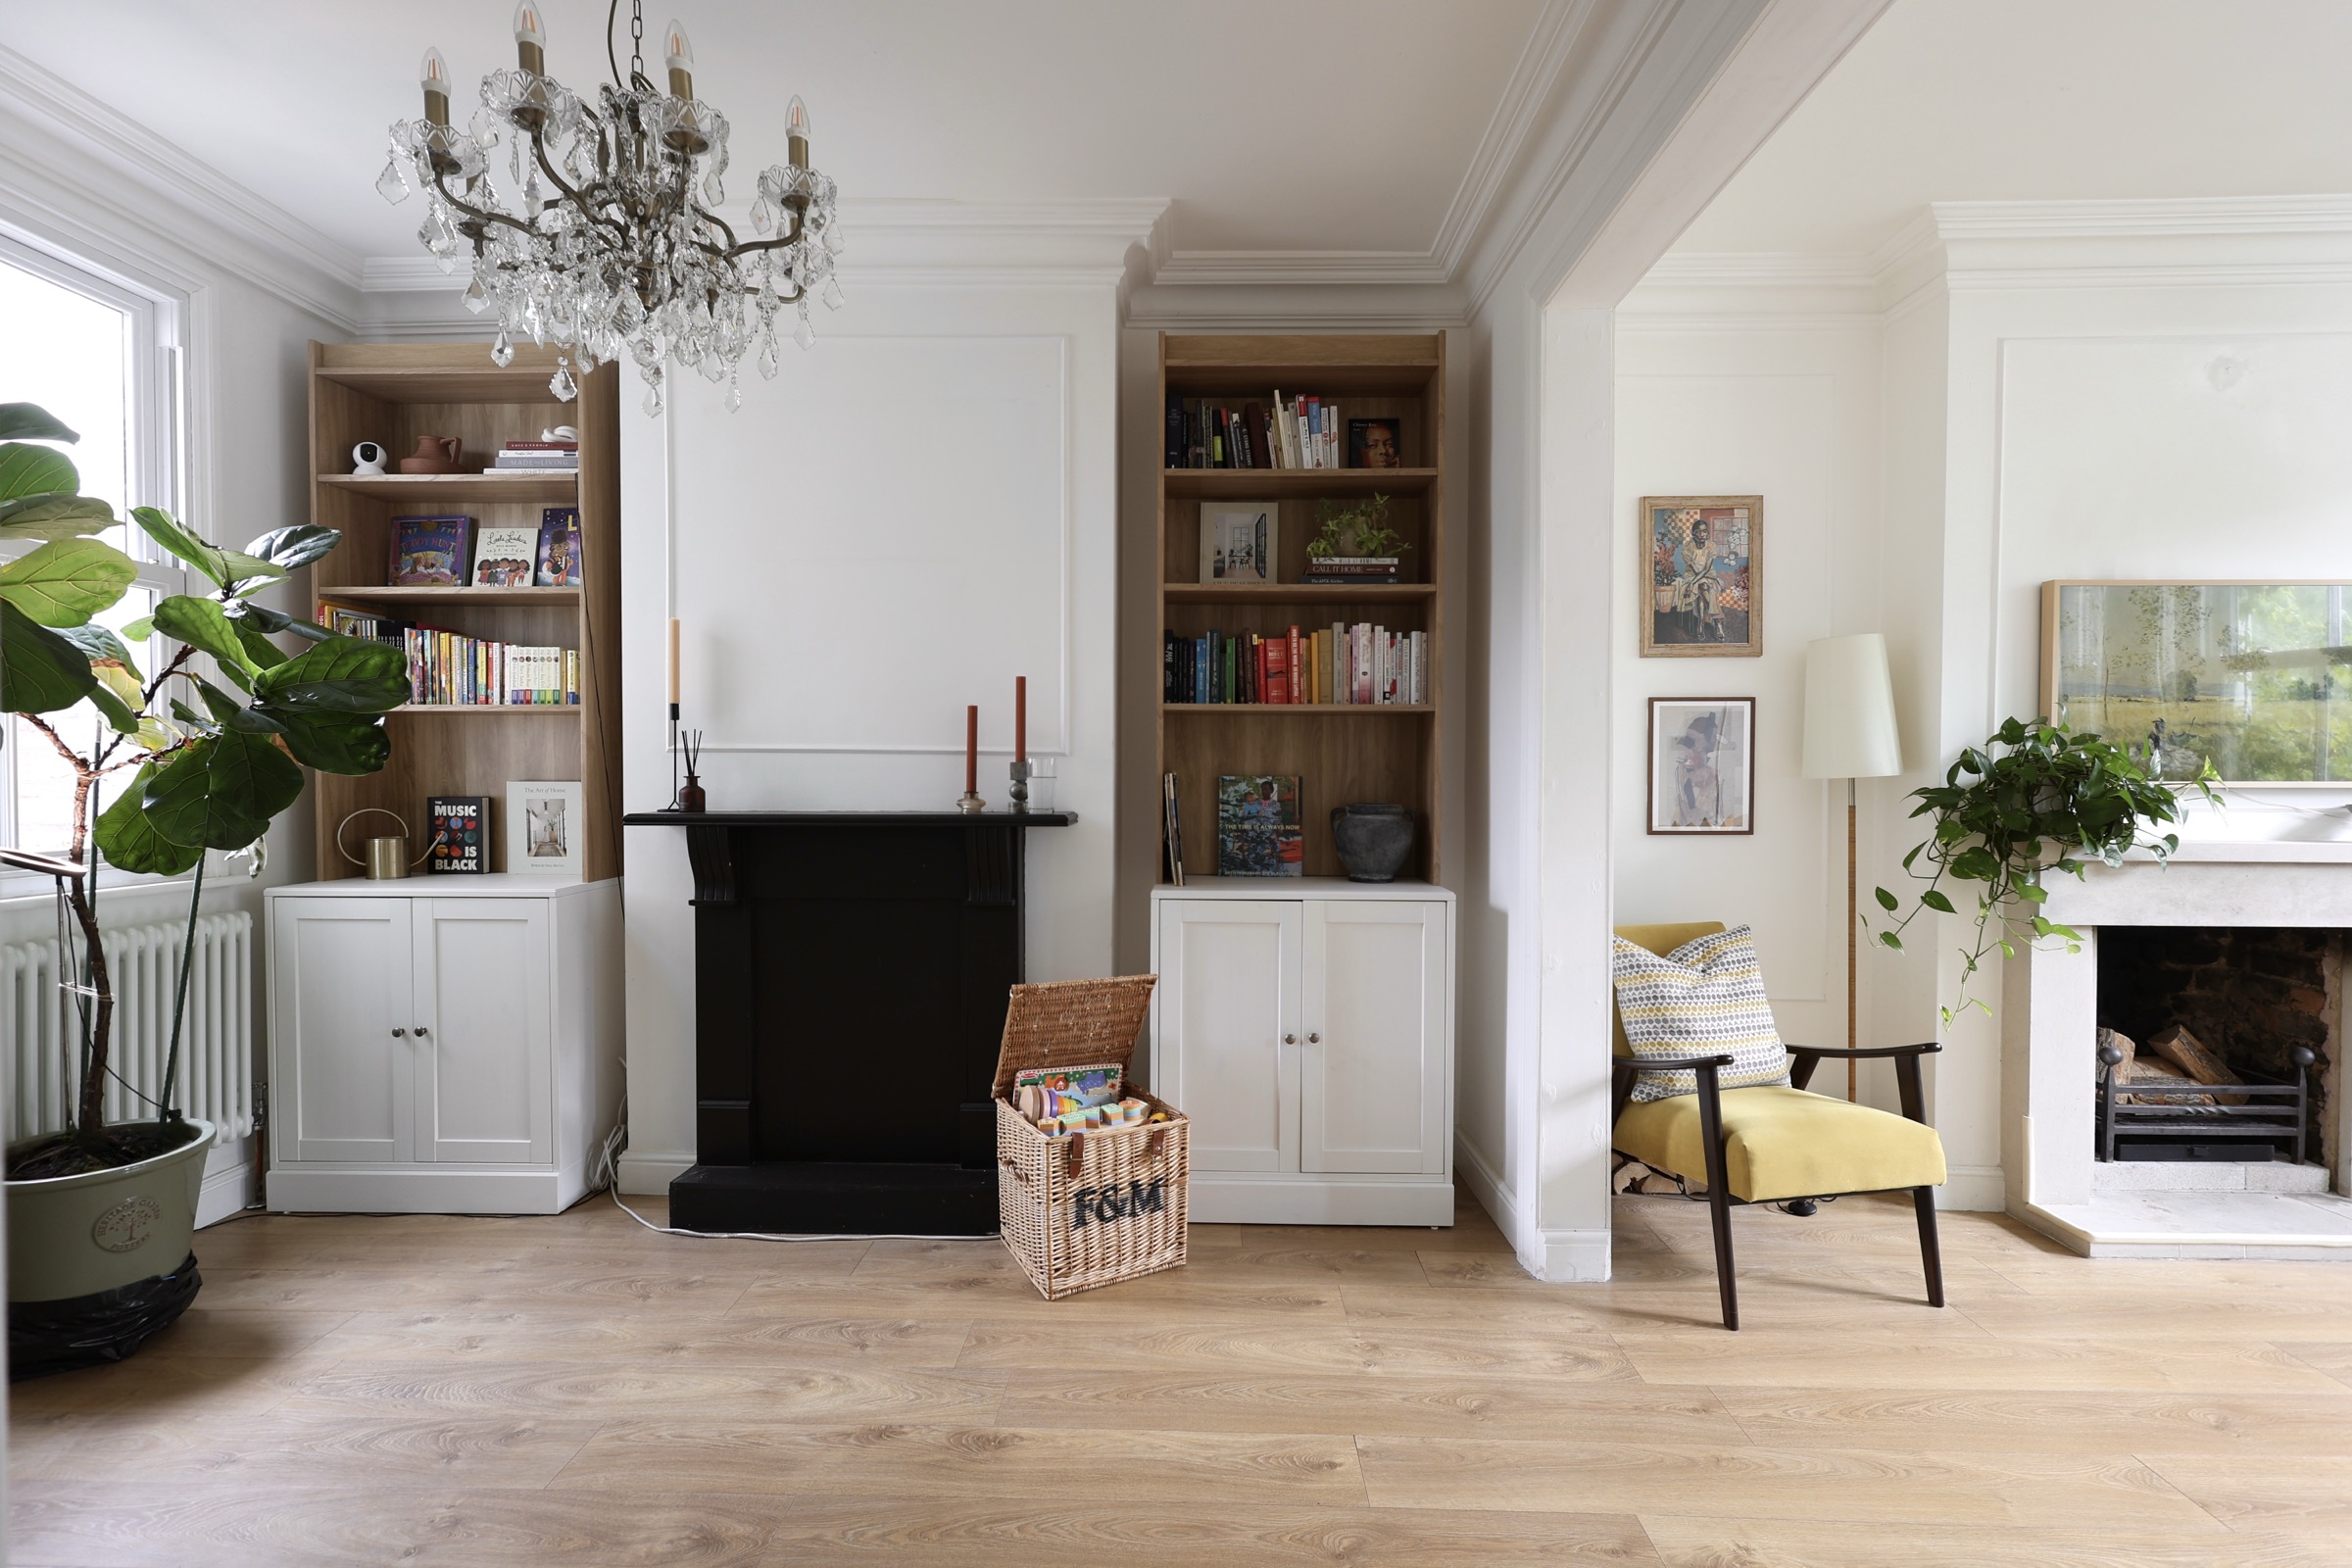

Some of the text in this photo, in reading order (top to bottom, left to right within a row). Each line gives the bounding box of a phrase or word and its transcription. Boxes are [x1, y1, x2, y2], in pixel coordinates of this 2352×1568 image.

[434, 806, 478, 817] MUSIC
[465, 846, 478, 858] IS
[434, 859, 478, 870] BLACK
[1073, 1177, 1166, 1230] F&M
